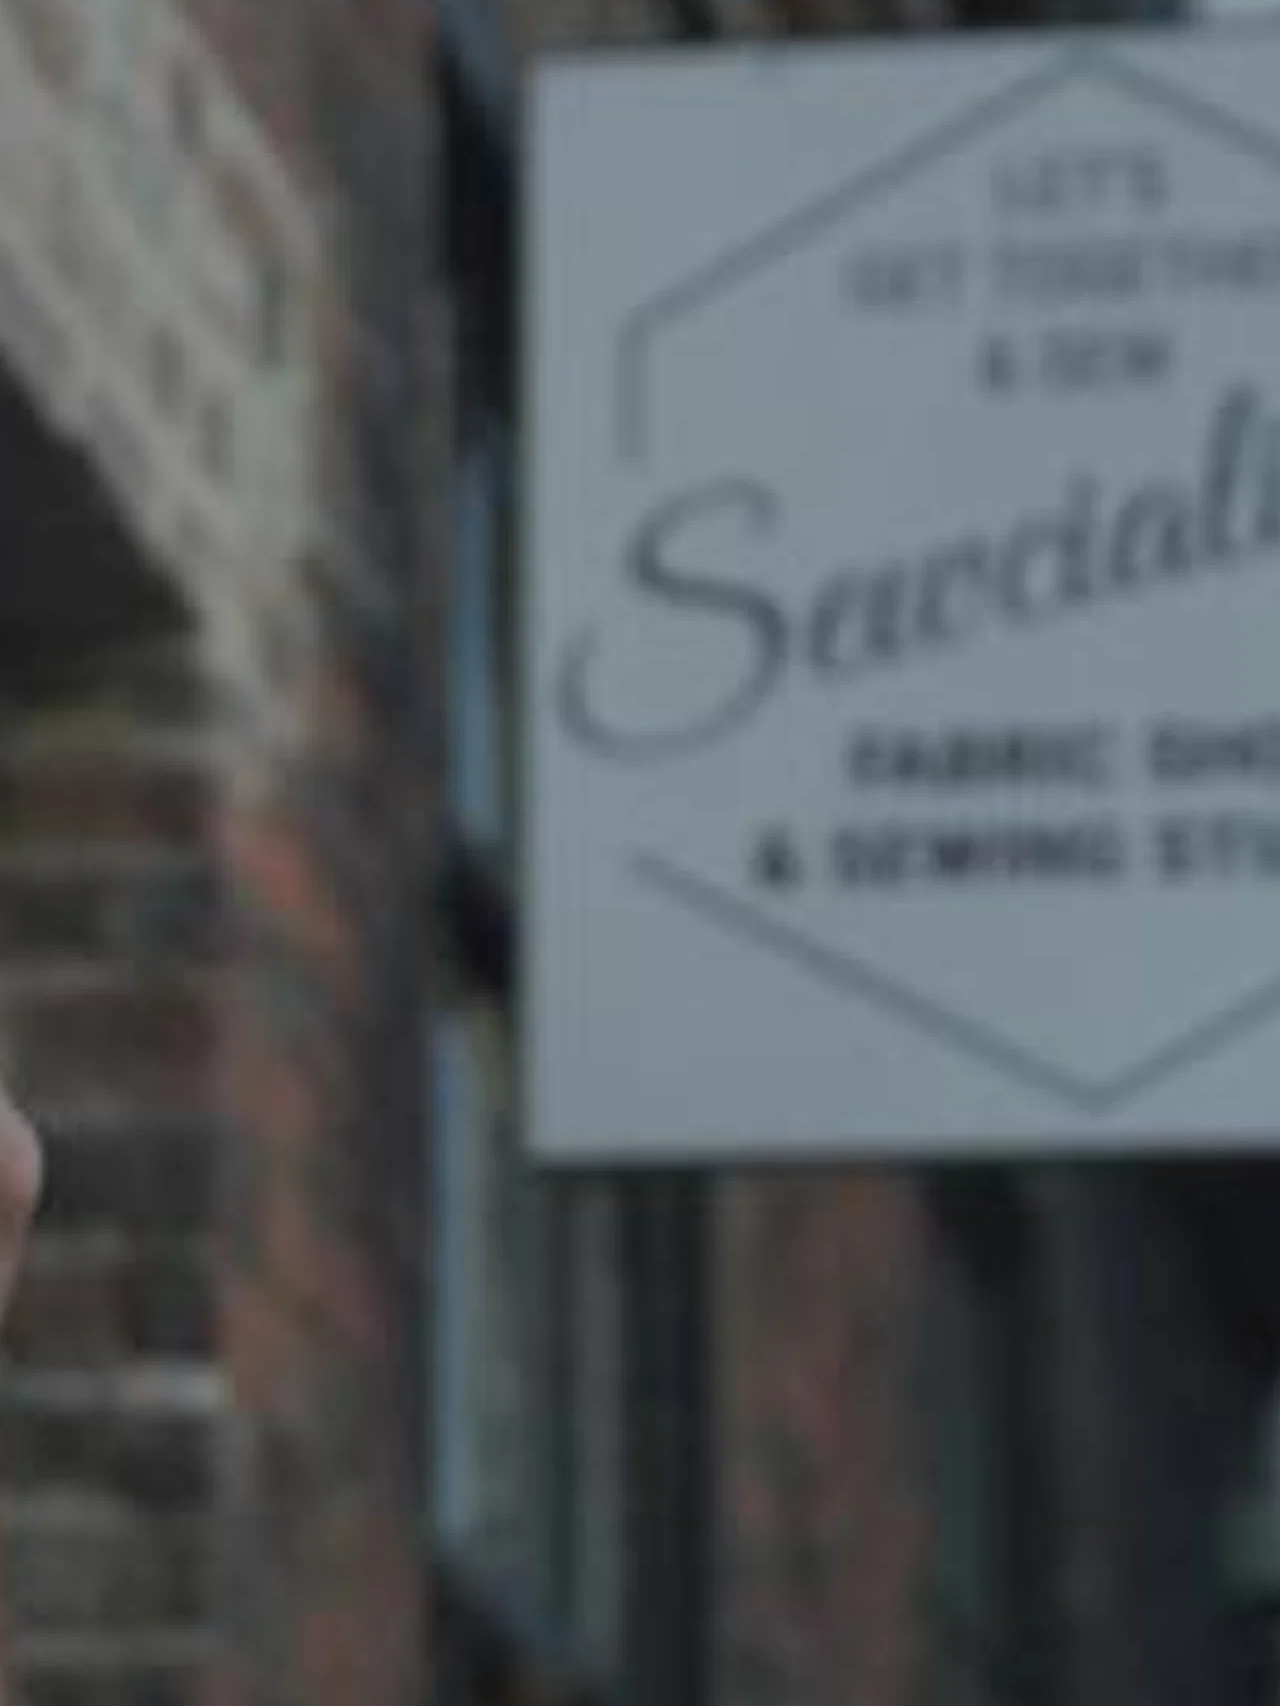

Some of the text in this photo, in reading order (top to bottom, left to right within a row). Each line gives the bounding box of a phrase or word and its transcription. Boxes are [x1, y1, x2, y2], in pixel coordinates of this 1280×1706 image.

[1040, 332, 1171, 389] SEW
[847, 725, 1107, 788] FABRIC
[750, 827, 803, 892] &
[829, 821, 1123, 886] SEWING
